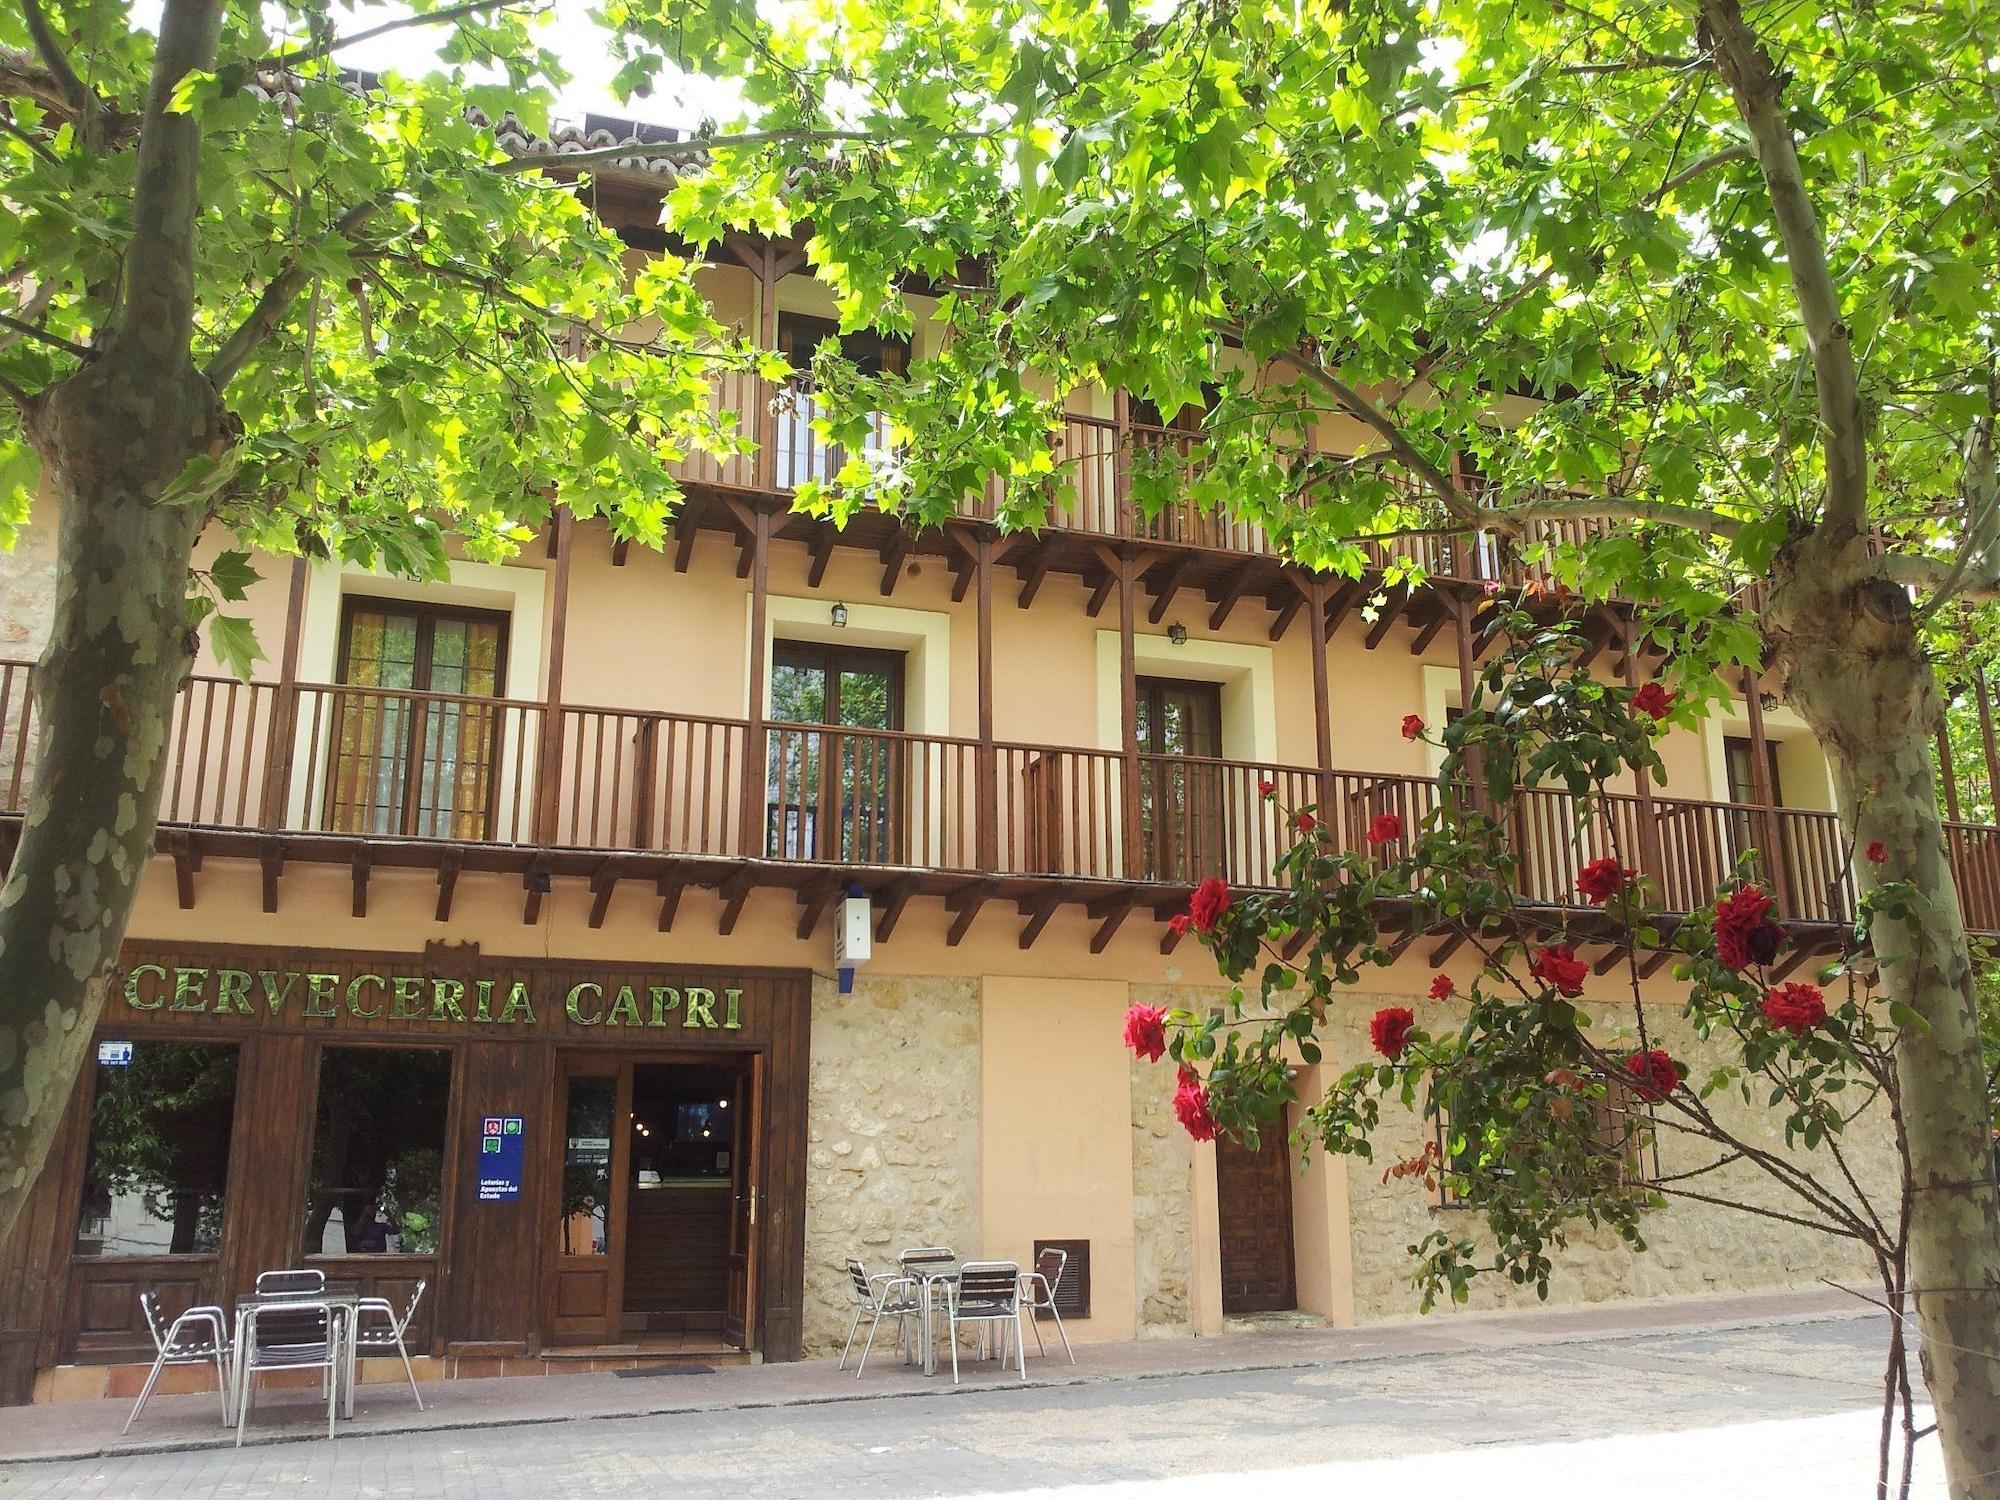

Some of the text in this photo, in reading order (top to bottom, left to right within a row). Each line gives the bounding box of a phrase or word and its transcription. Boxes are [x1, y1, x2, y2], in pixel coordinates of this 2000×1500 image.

[122, 964, 744, 1031] CERVECERIA CAPRI
[480, 1185, 508, 1193] Apuestas
